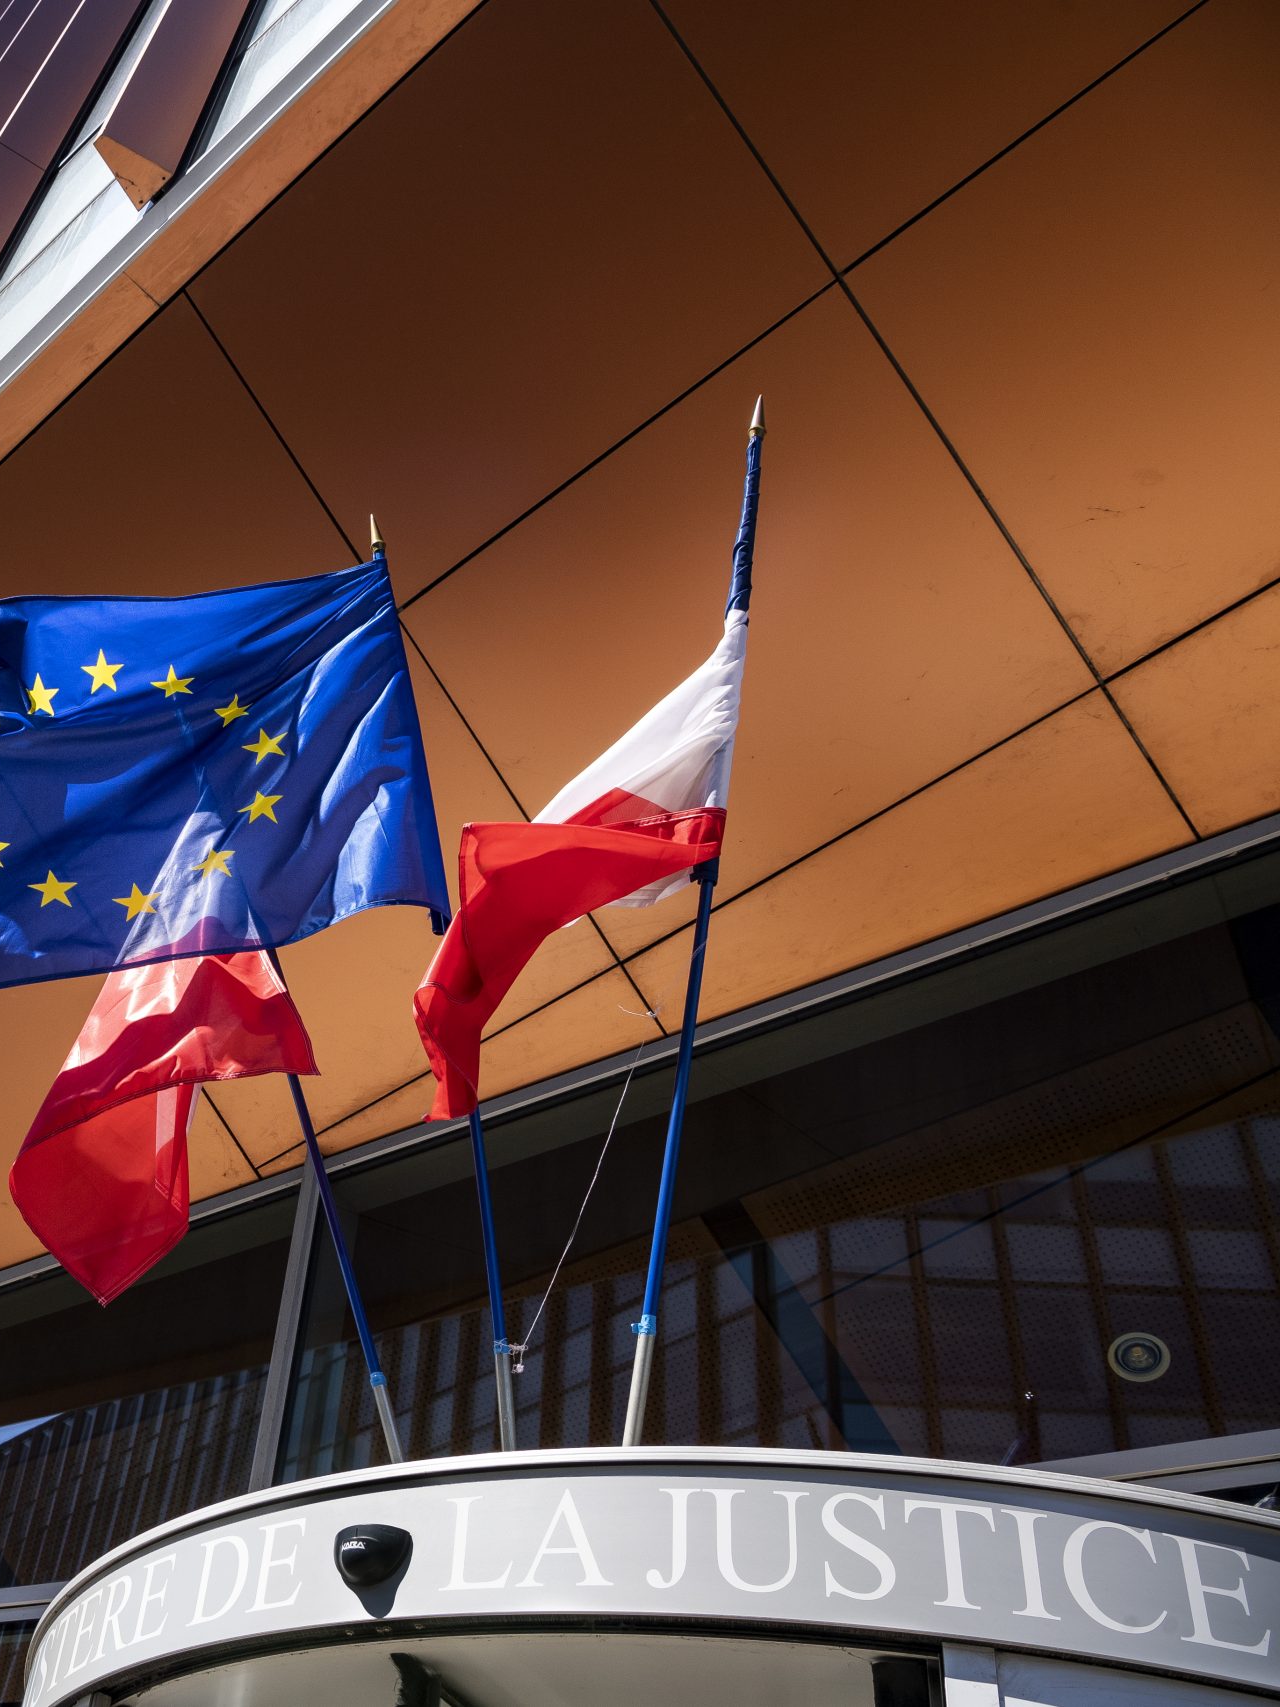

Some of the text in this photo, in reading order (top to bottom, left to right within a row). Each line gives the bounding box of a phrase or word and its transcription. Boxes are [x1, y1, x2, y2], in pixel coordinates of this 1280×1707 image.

[185, 1517, 307, 1627] DE
[438, 1488, 614, 1591] LA
[646, 1488, 1270, 1657] JUSTICE
